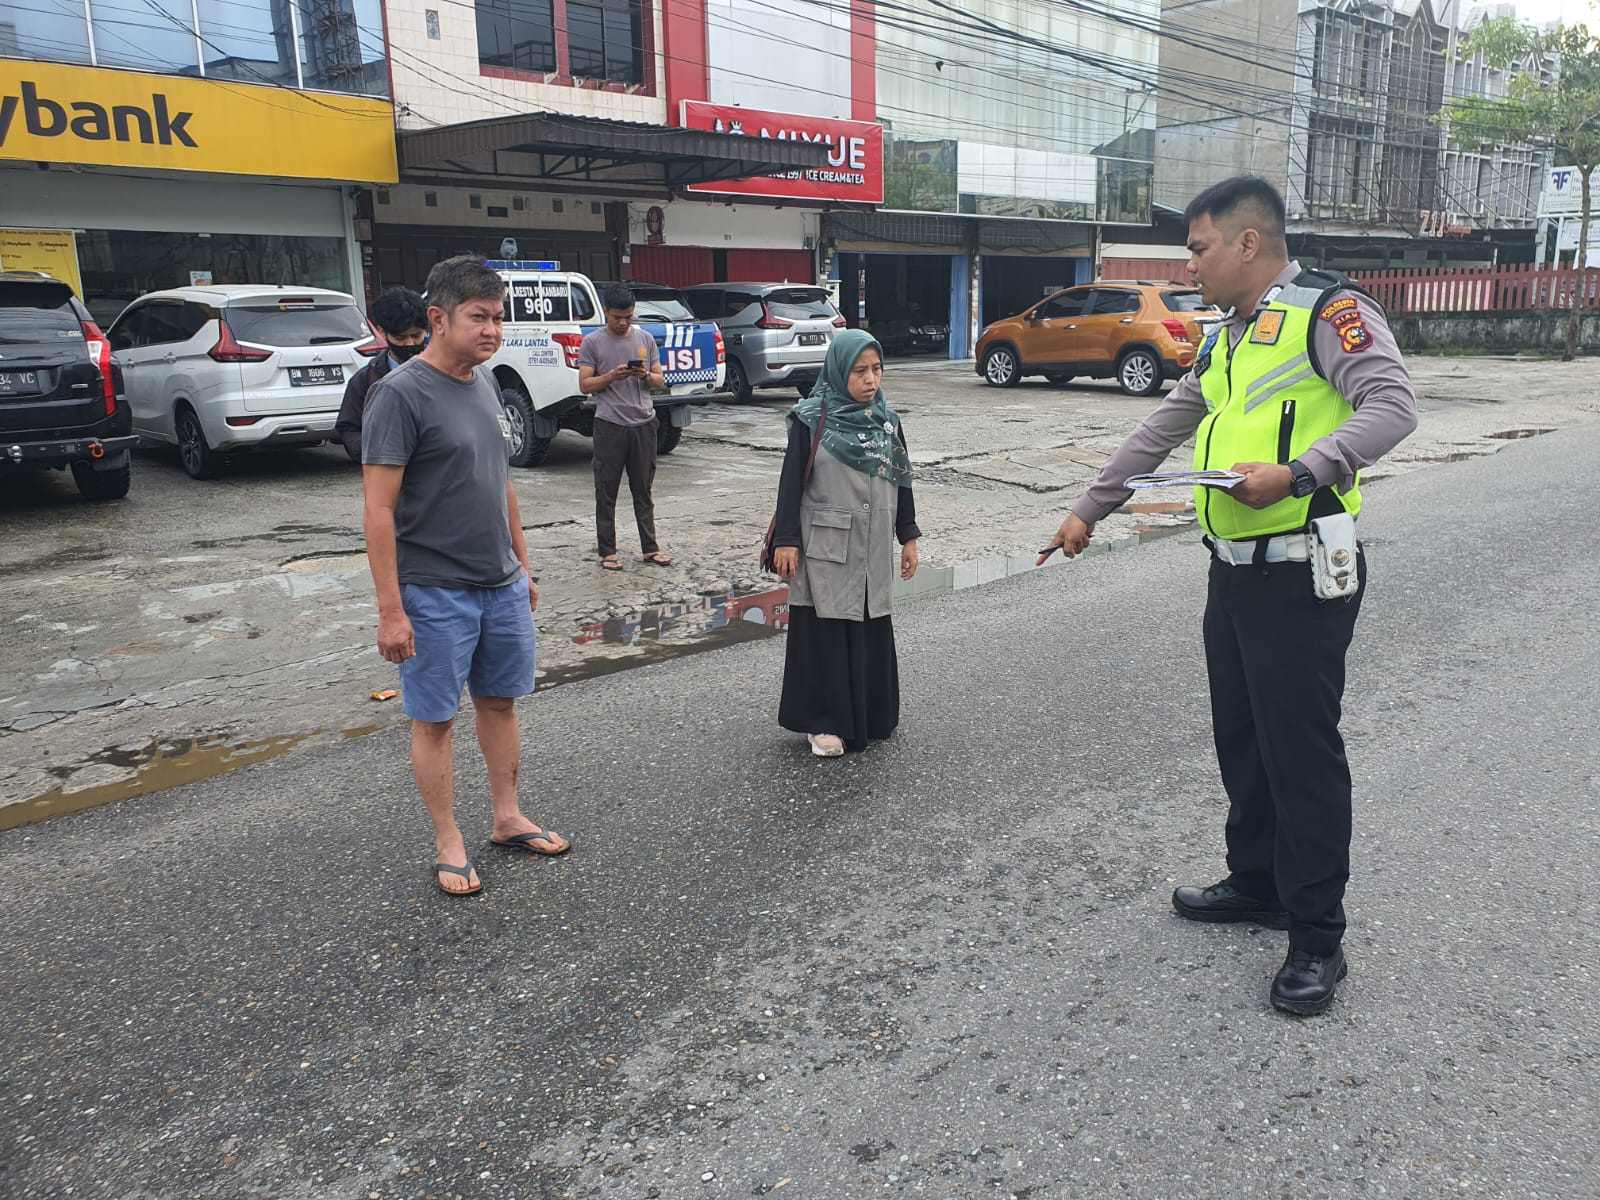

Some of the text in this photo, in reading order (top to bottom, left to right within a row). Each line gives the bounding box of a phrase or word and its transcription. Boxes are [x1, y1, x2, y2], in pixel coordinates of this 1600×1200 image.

[805, 170, 818, 181] ICE
[819, 171, 865, 185] CREAM&TEA
[505, 286, 568, 298] PLRESTA PKANBARU
[524, 298, 552, 315] 960
[1335, 312, 1358, 325] RIAU
[507, 338, 523, 347] LAKA
[525, 338, 549, 347] LANTAS
[19, 372, 35, 384] VC
[331, 367, 342, 377] VS
